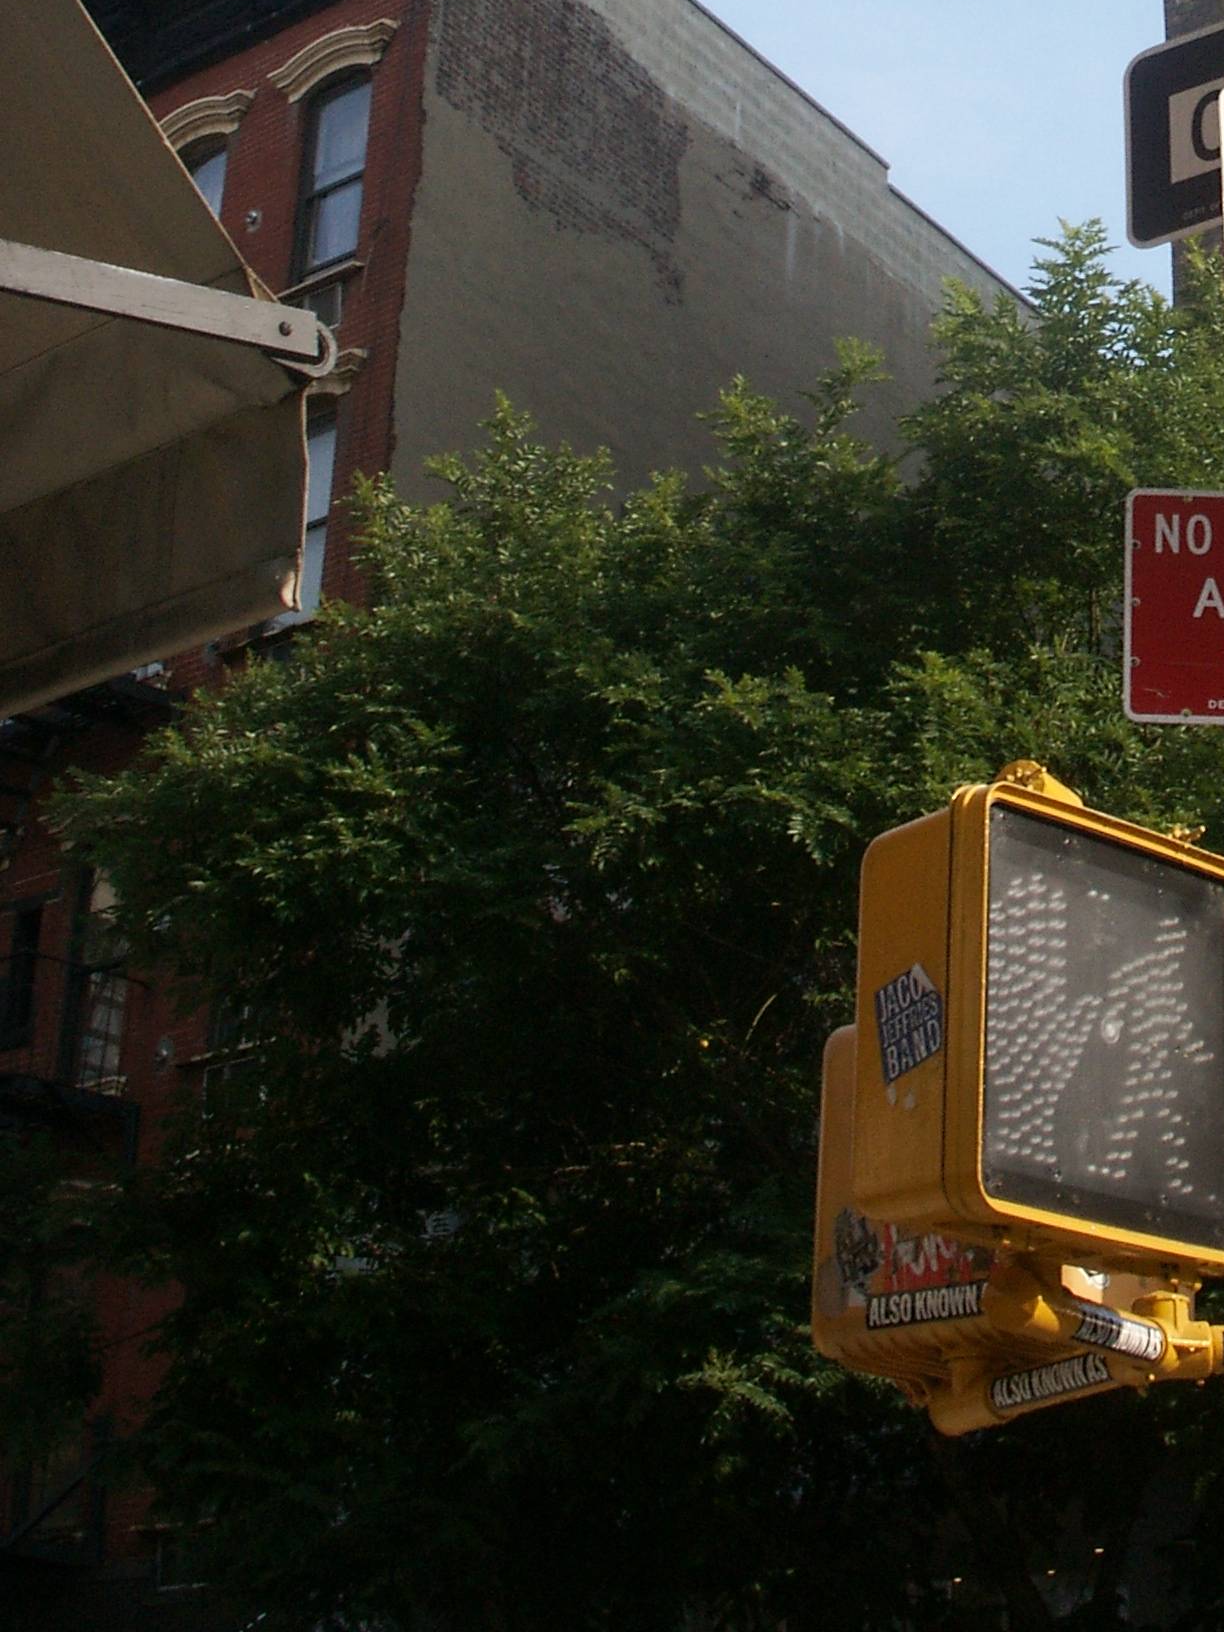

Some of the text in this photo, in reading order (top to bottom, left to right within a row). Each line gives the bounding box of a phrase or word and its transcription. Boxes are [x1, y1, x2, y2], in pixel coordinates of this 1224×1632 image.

[1154, 513, 1214, 556] NO
[886, 1019, 940, 1079] BAND
[868, 1293, 912, 1327] ALSO
[915, 1283, 978, 1320] KNOWN
[992, 1352, 1109, 1408] ALSO KNOWN AS
